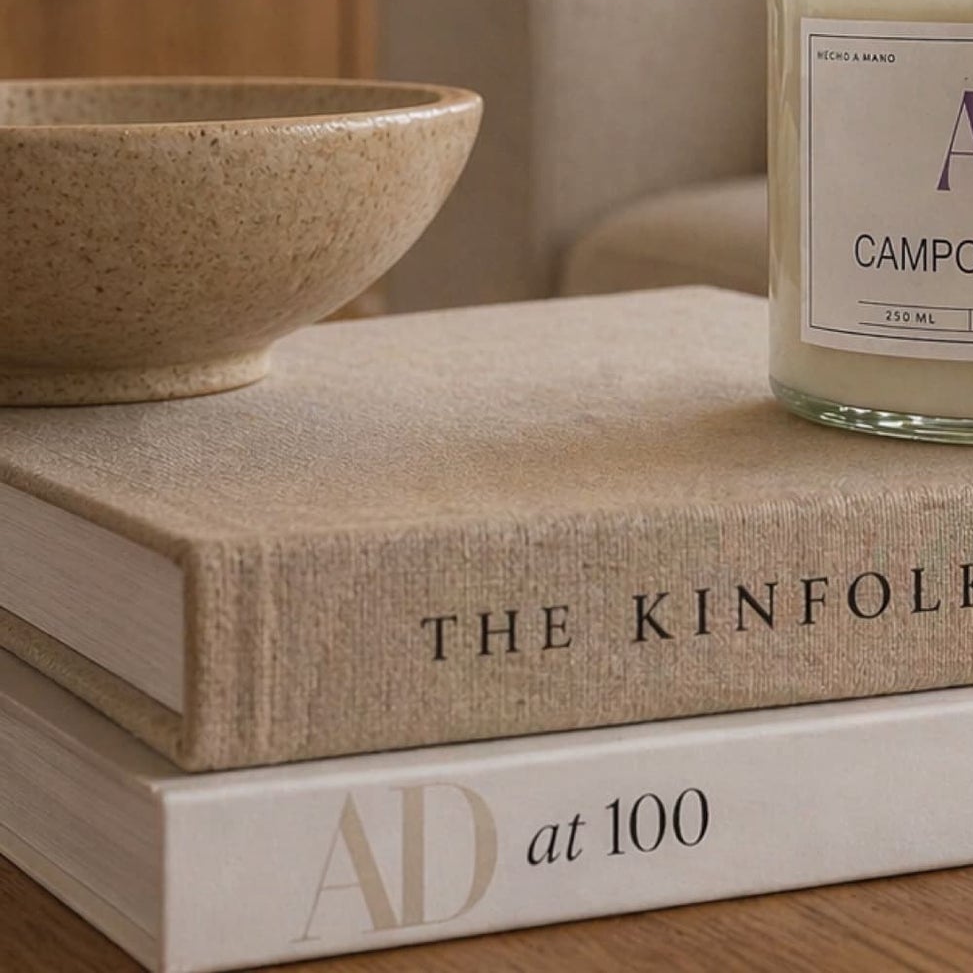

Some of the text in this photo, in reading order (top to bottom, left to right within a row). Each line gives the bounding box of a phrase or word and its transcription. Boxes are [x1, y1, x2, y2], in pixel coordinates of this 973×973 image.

[853, 53, 860, 62] A
[862, 53, 896, 63] MANO
[885, 310, 936, 325] 250 ML
[420, 604, 573, 661] THE
[288, 781, 710, 944] AD at 100
